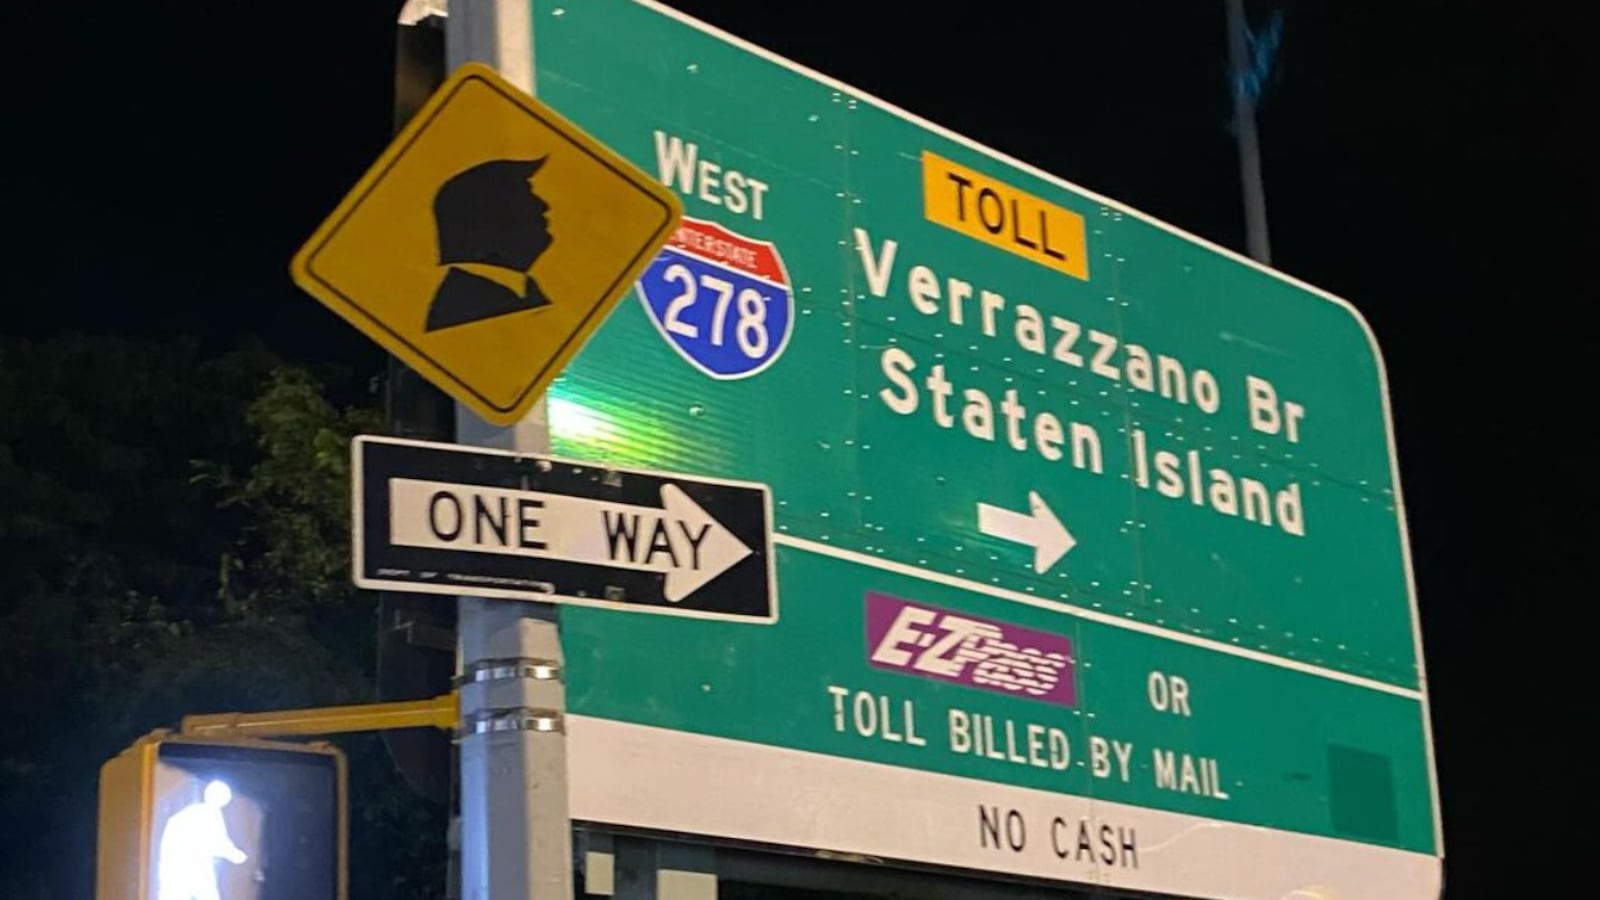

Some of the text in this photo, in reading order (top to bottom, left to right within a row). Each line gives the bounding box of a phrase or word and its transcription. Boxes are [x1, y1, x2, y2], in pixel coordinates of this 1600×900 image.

[653, 130, 769, 221] WEST
[946, 172, 1067, 262] TOLL
[669, 227, 759, 270] NTERSTATE
[663, 263, 769, 360] 278
[853, 227, 1306, 443] Verrazzano Br
[879, 347, 1306, 537] Staten Island
[428, 490, 713, 571] ONE WAY
[1147, 671, 1192, 718] OR
[827, 685, 1230, 801] TOLL BILLED BY MAIL
[978, 804, 1140, 870] NO CASH
